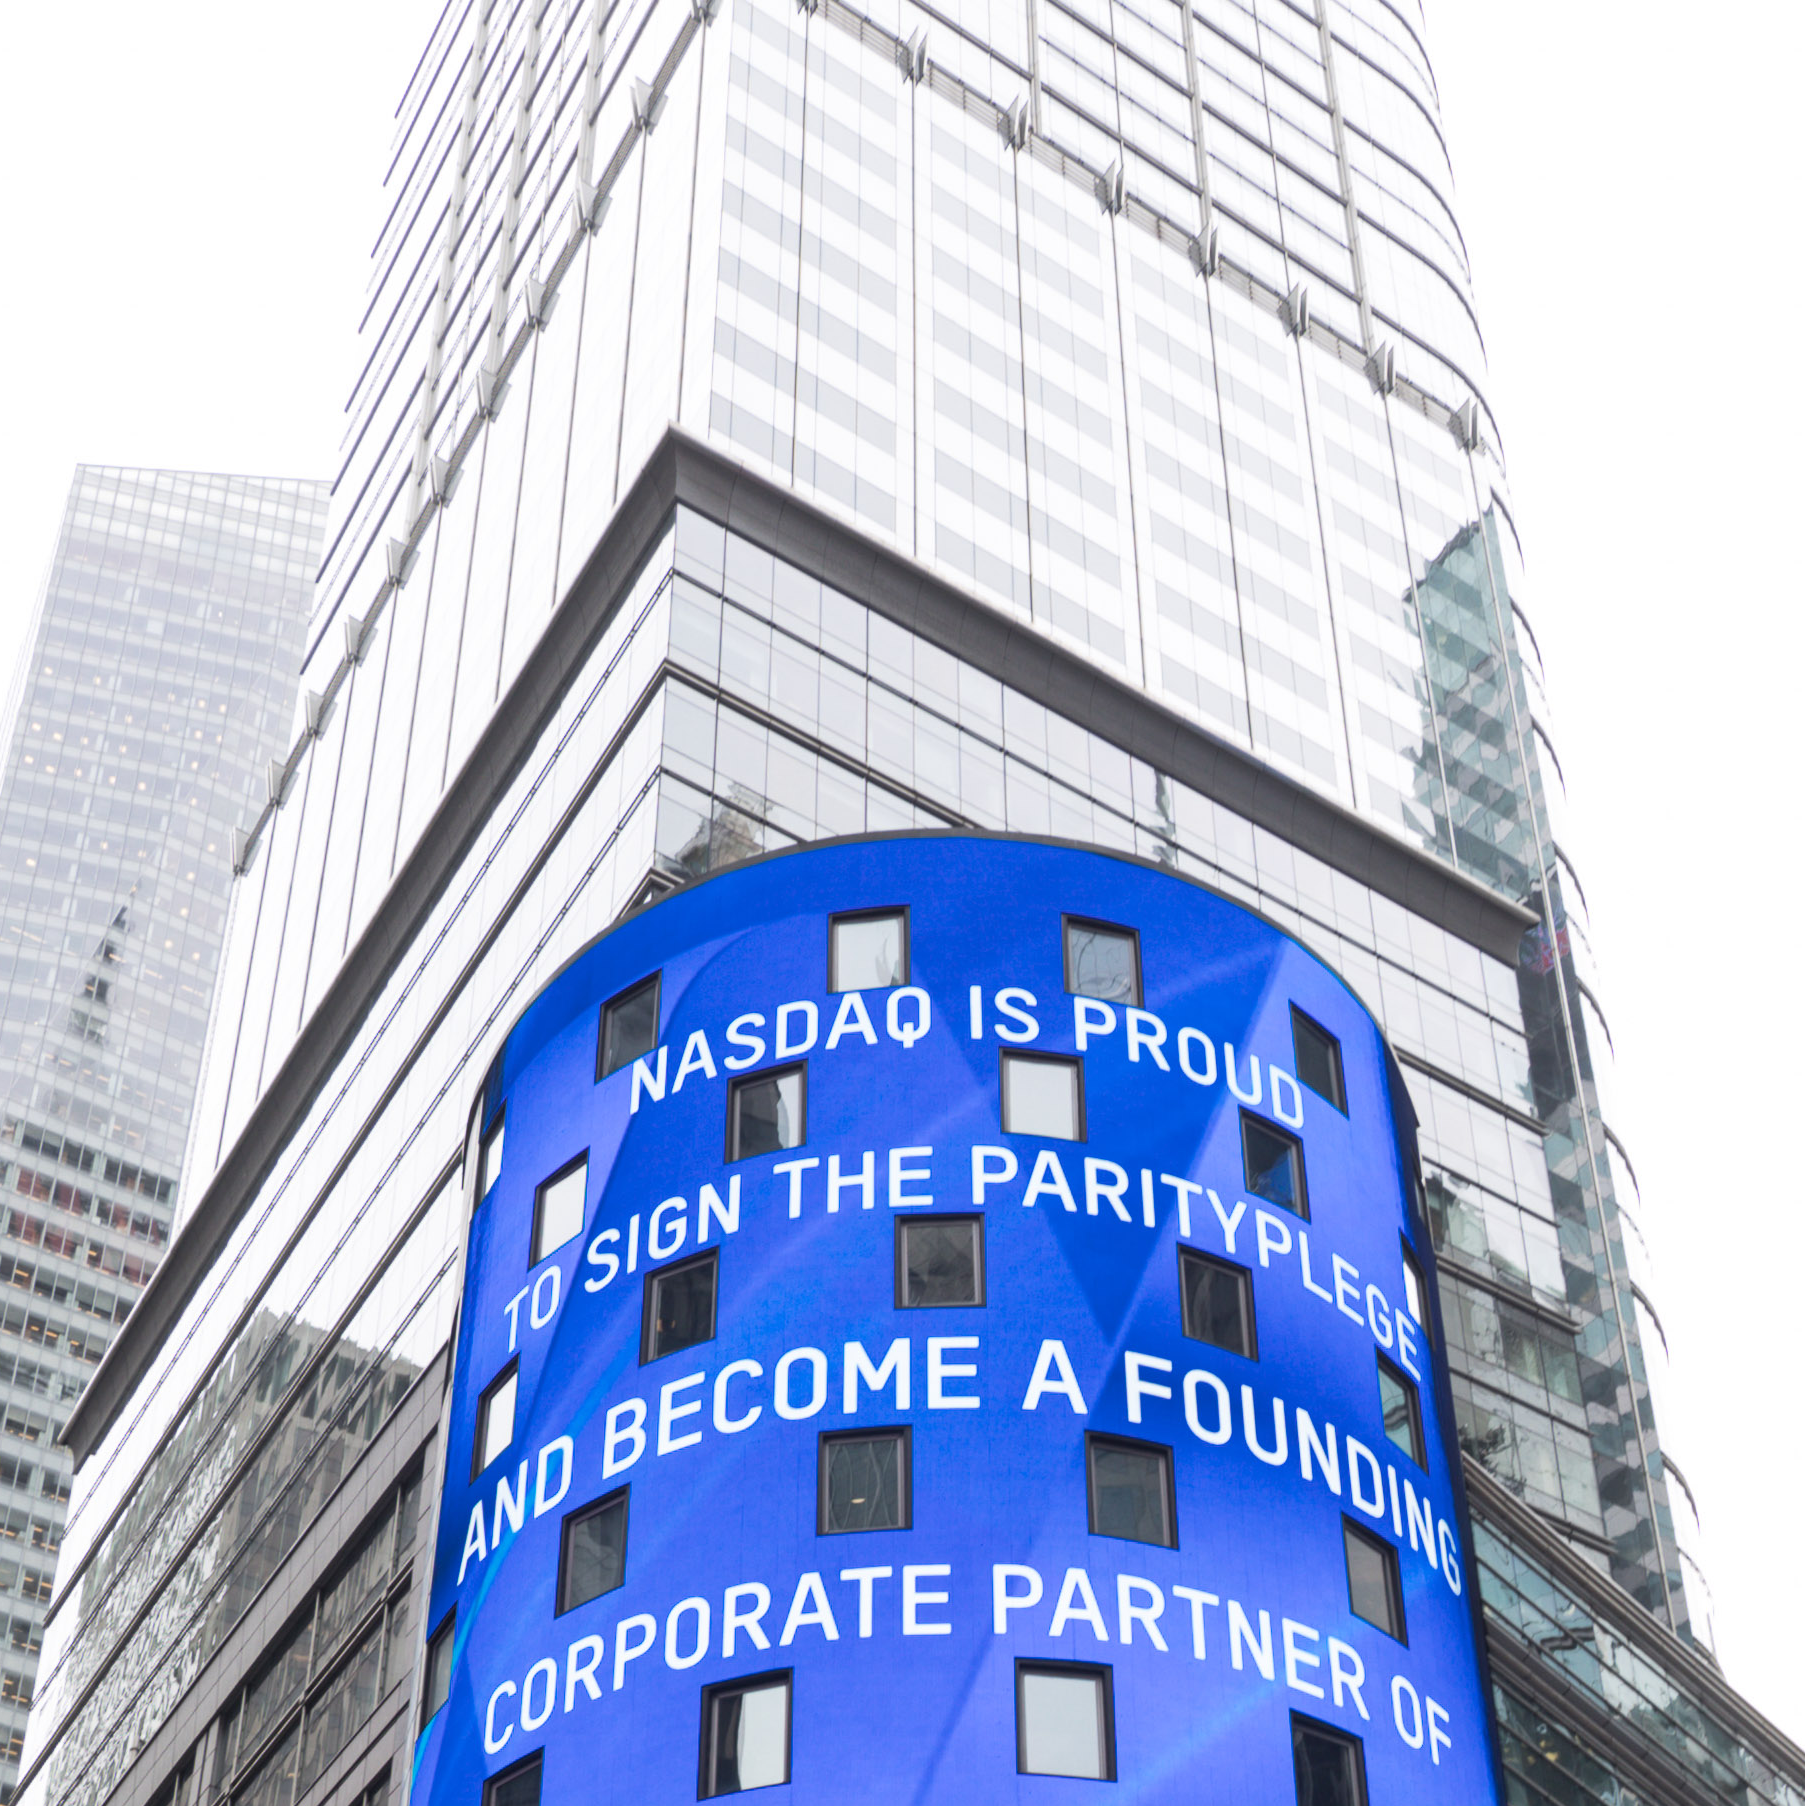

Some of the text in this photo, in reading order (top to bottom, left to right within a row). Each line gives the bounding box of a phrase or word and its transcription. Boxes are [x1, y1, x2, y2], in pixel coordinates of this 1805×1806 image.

[629, 985, 1305, 1128] NASDAQ IS PROUD
[504, 1145, 1422, 1382] TO SIGN THE PARITYPLEGE
[457, 1336, 1463, 1597] AND BECOME A FOUNDING
[483, 1563, 1452, 1766] CORPORATE PARTNER OF
